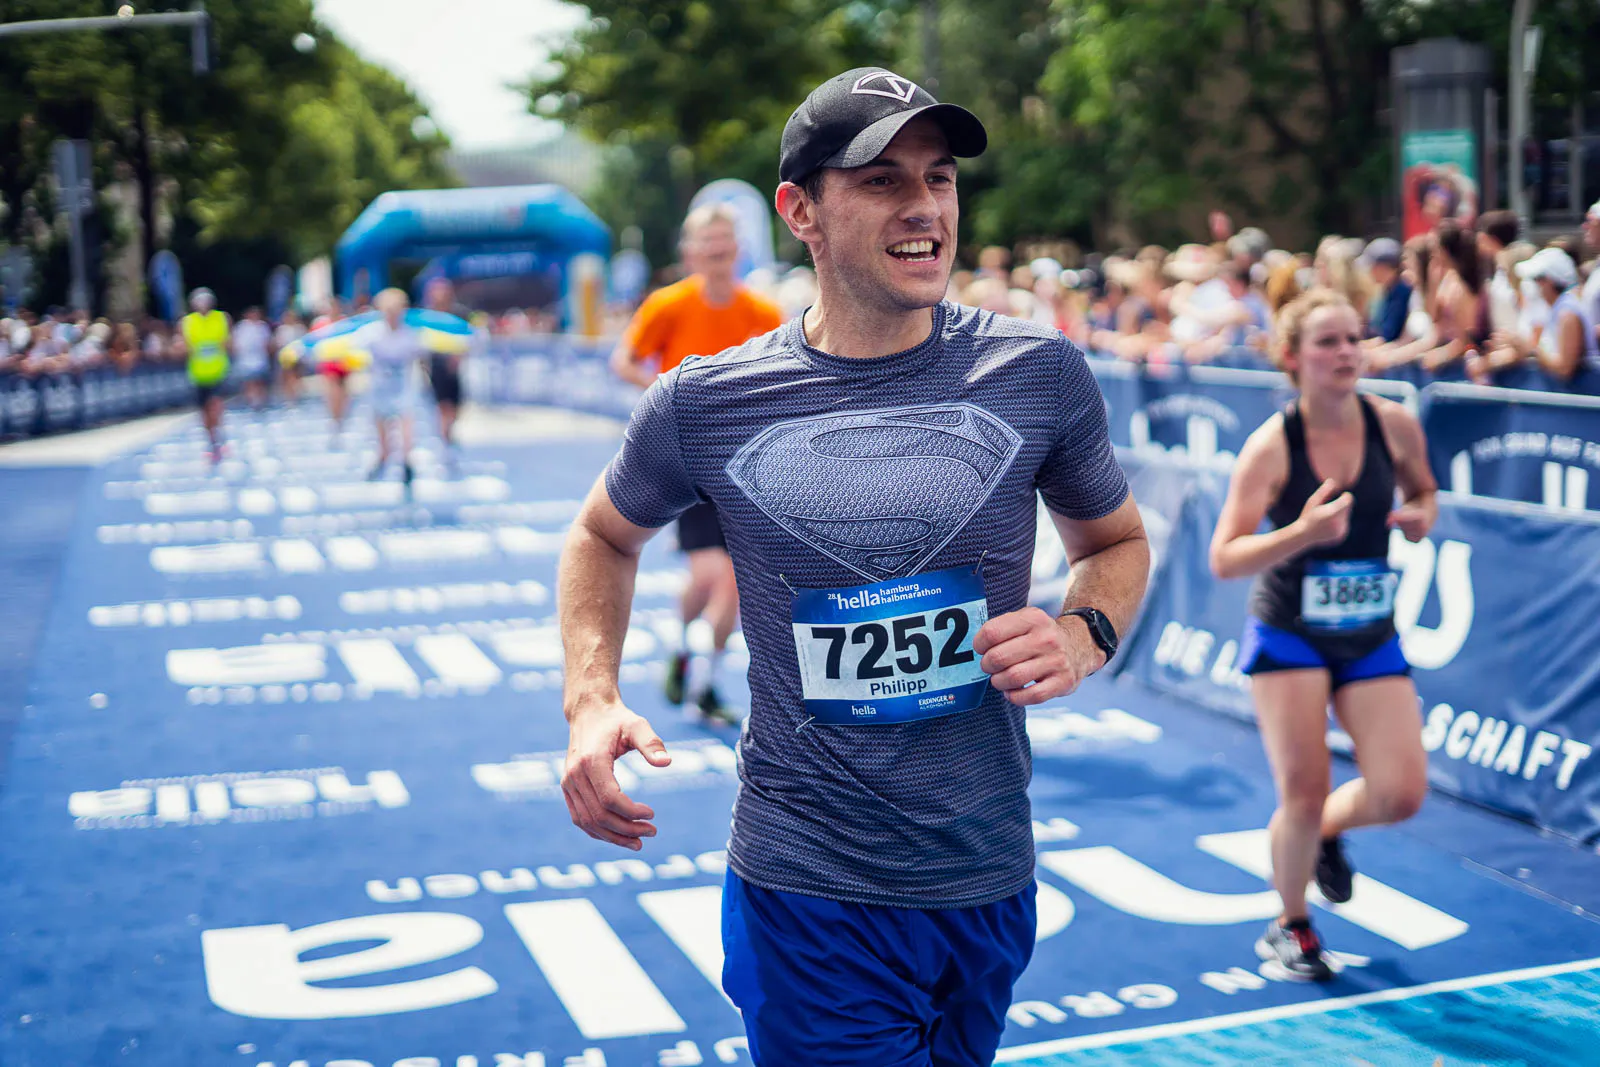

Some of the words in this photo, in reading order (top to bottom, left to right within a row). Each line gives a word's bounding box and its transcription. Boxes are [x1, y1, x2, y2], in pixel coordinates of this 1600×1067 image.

[880, 583, 920, 596] hamburg
[880, 587, 942, 605] halbmarathon
[1315, 574, 1384, 606] 3865
[837, 589, 881, 610] hella
[811, 607, 975, 680] 7252
[1153, 620, 1217, 676] DIE
[870, 679, 928, 696] Philipp
[918, 694, 949, 706] ERDINGER
[852, 705, 877, 716] hella
[68, 770, 410, 823] hella
